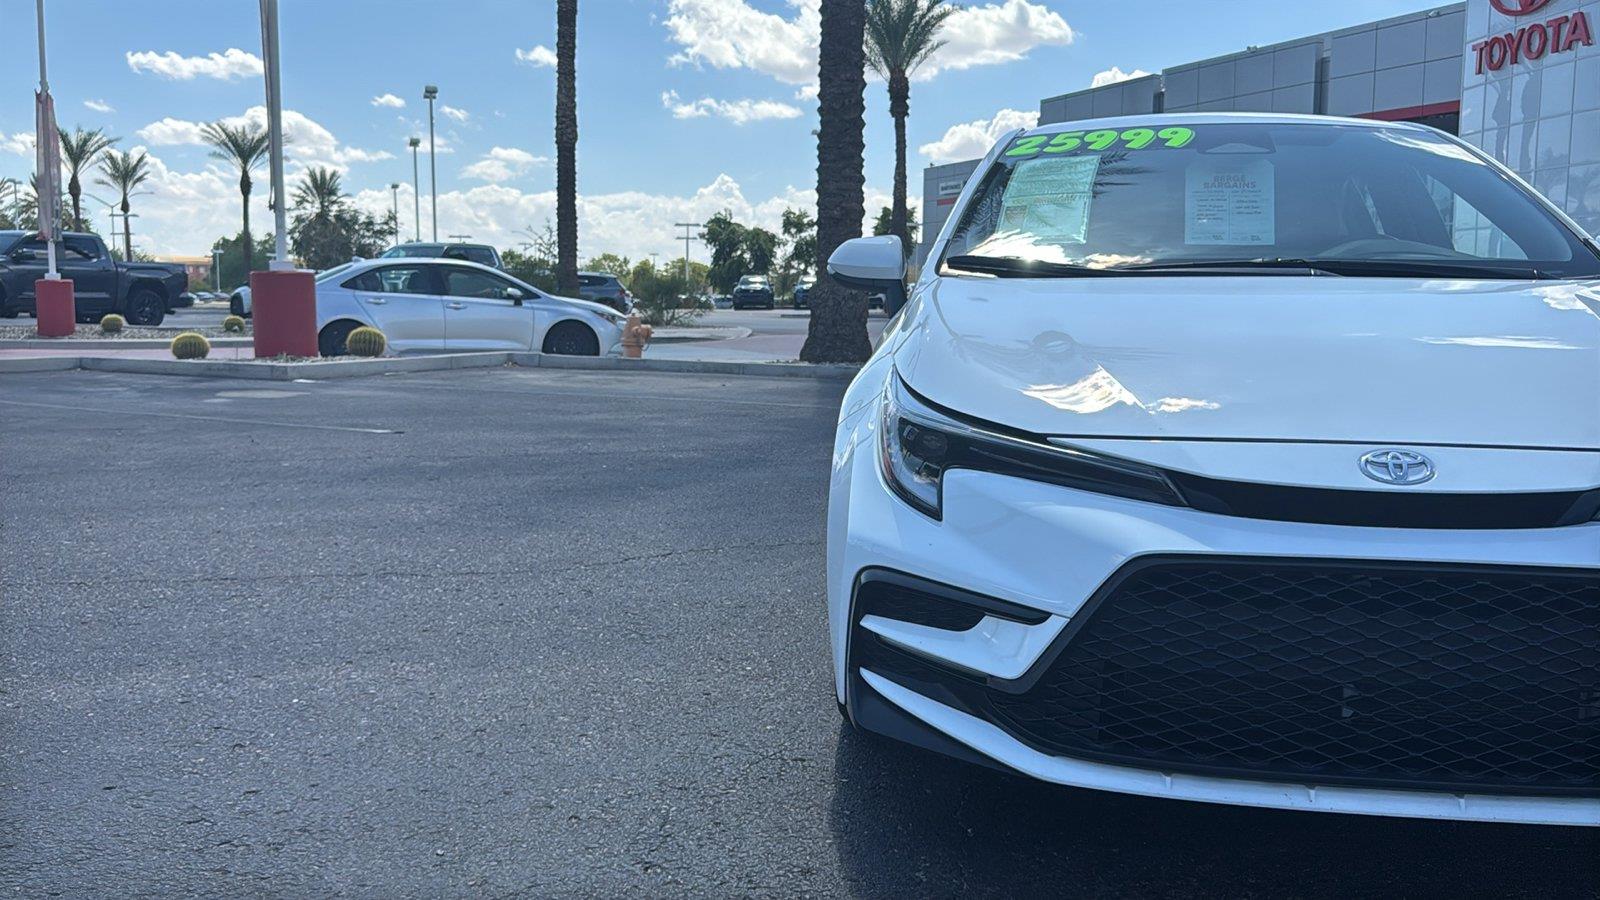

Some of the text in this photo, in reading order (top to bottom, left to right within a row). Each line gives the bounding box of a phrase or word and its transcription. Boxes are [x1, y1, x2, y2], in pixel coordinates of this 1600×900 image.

[1472, 11, 1593, 75] TOYOTA
[1006, 127, 1195, 156] 25999
[1203, 181, 1257, 189] BARGAINS
